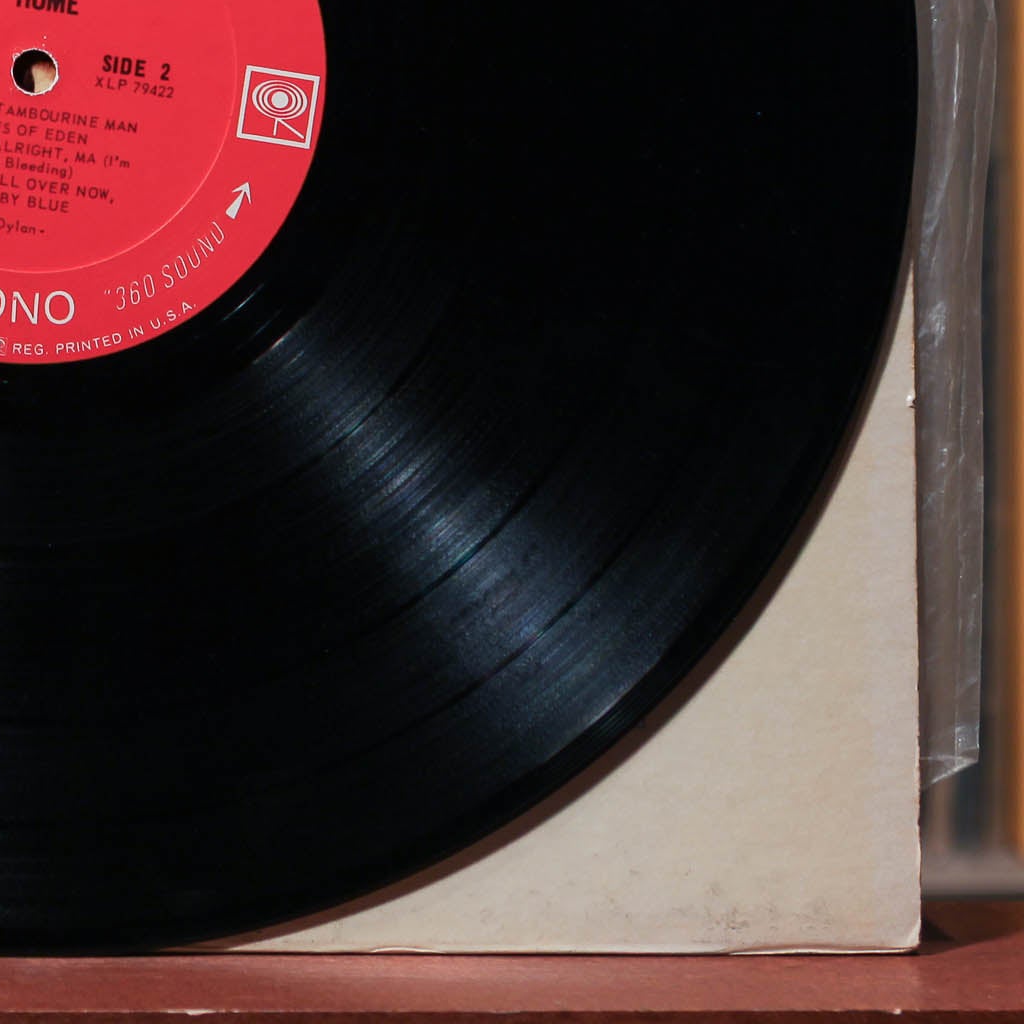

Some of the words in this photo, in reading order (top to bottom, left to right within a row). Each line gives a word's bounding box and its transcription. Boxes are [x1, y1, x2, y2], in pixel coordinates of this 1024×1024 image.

[102, 54, 146, 77] SIDE
[160, 63, 171, 81] 2
[95, 76, 128, 90] XLP
[133, 81, 174, 98] 79422
[17, 125, 38, 137] OF
[45, 128, 89, 145] EDEN
[104, 119, 138, 133] MAN
[5, 156, 74, 180] Bleeding)
[75, 151, 96, 164] MA
[103, 154, 130, 169] (I'm
[26, 178, 70, 195] OVER
[76, 186, 115, 205] NOW,
[27, 196, 70, 213] BLUE
[12, 343, 49, 356] REG.
[56, 332, 123, 354] PRINTED
[128, 326, 144, 339] IN
[150, 300, 197, 330] U.S.A.
